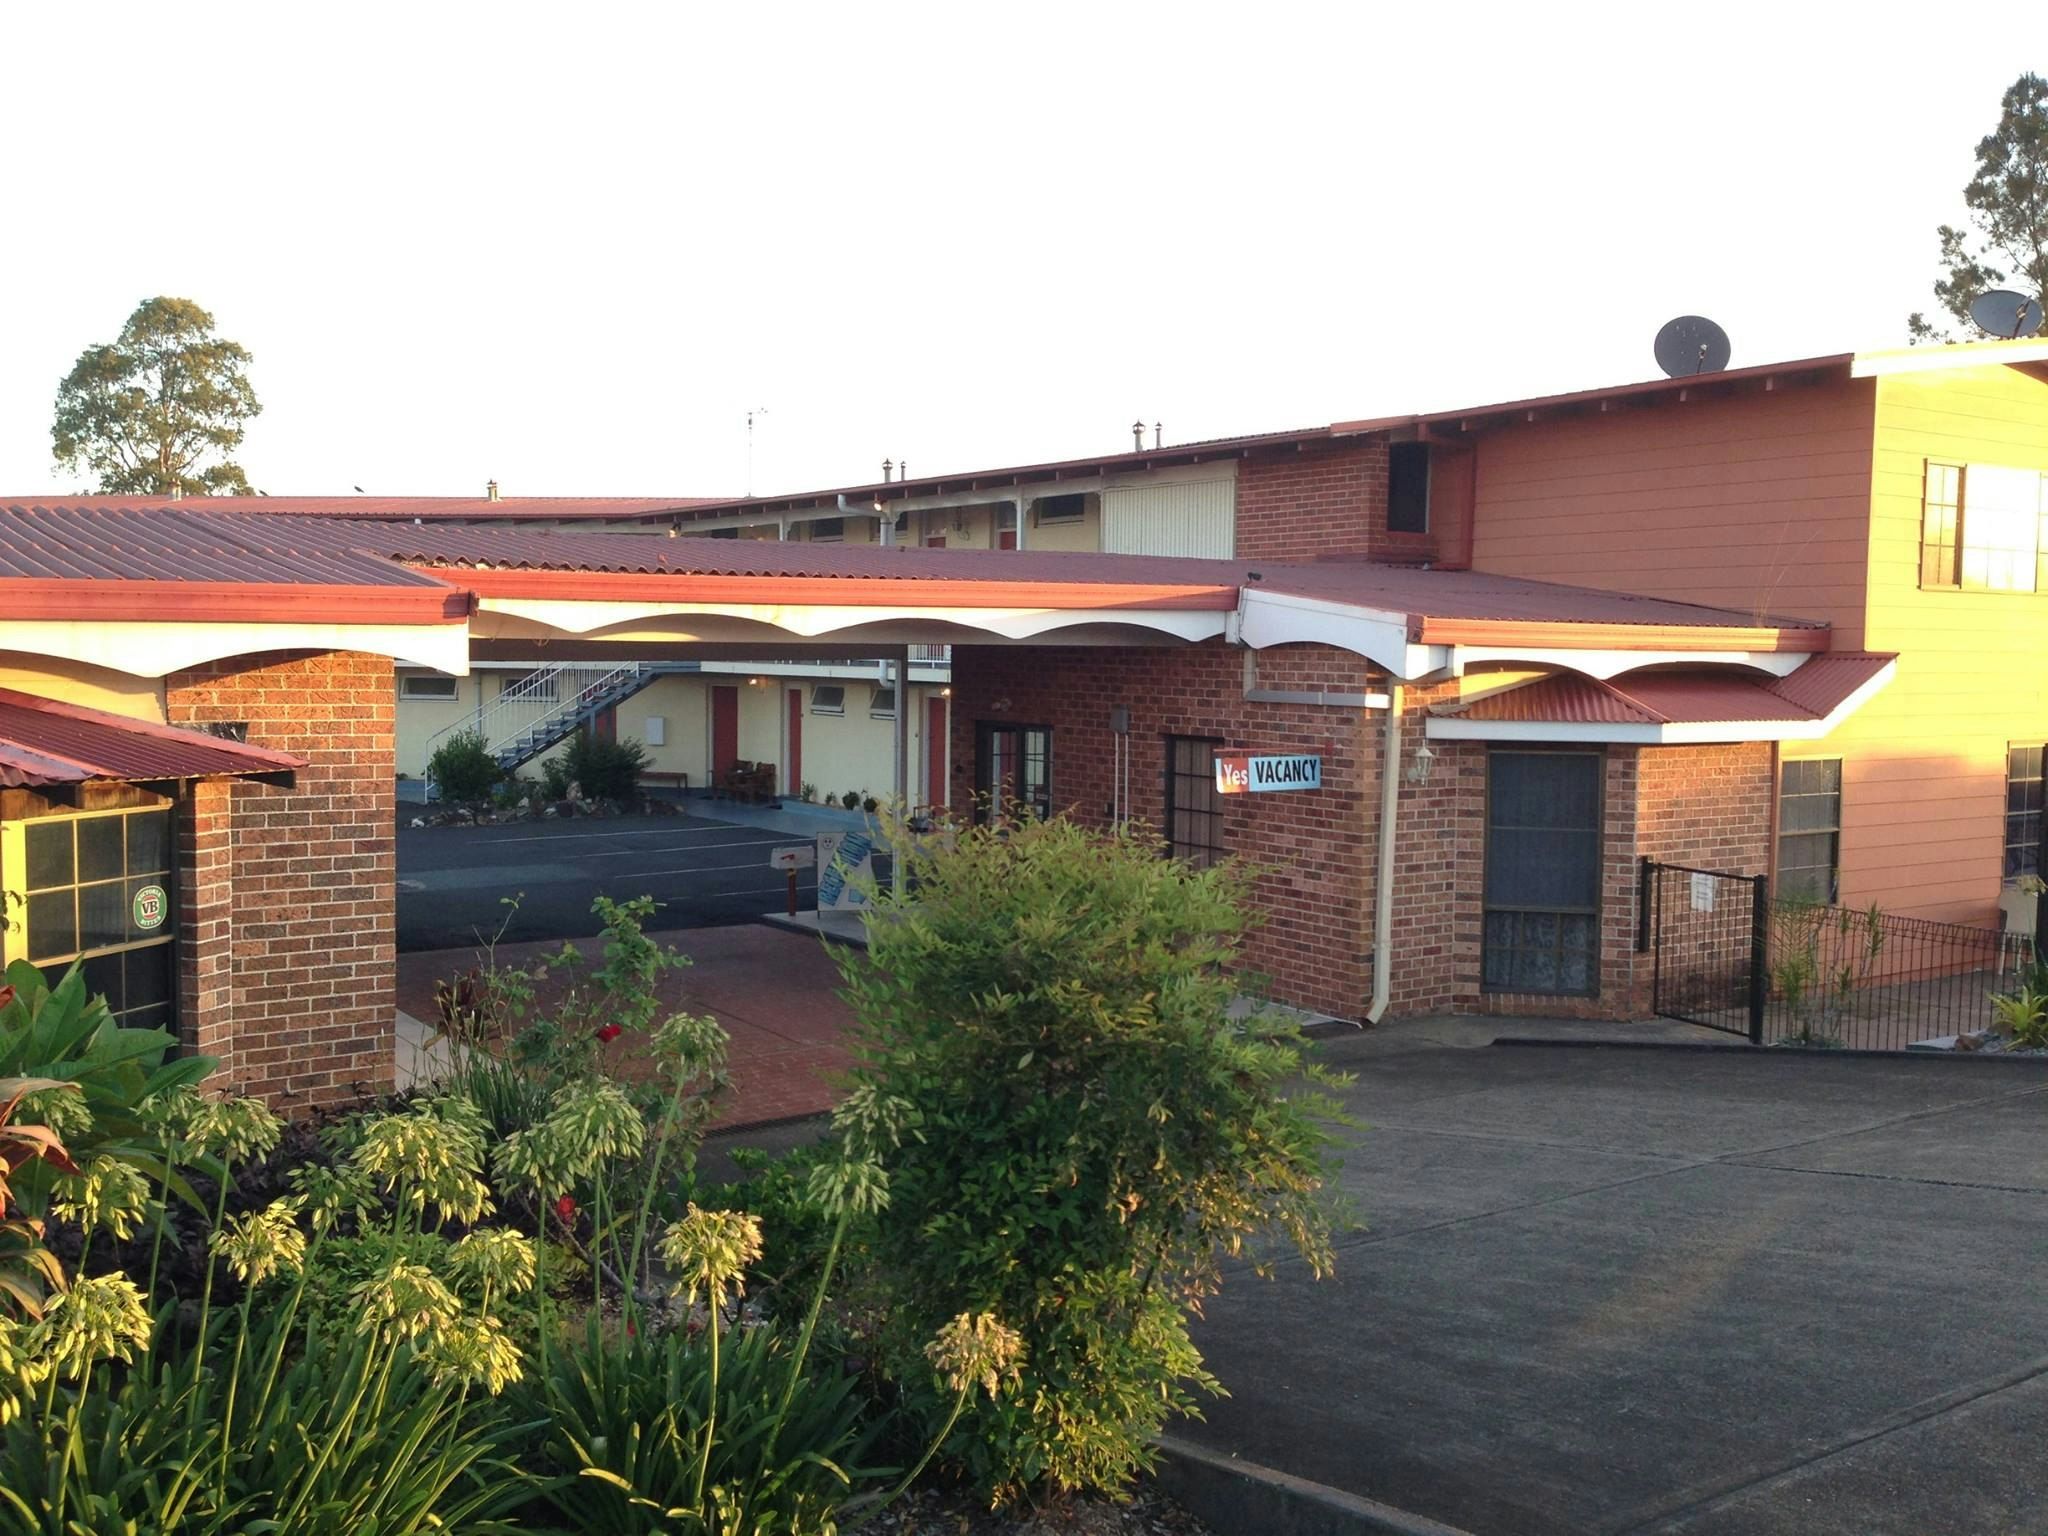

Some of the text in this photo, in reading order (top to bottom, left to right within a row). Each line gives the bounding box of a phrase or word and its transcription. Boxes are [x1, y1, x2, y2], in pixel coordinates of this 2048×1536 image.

[1223, 759, 1317, 785] Yes VACANCY
[142, 900, 158, 914] VB
